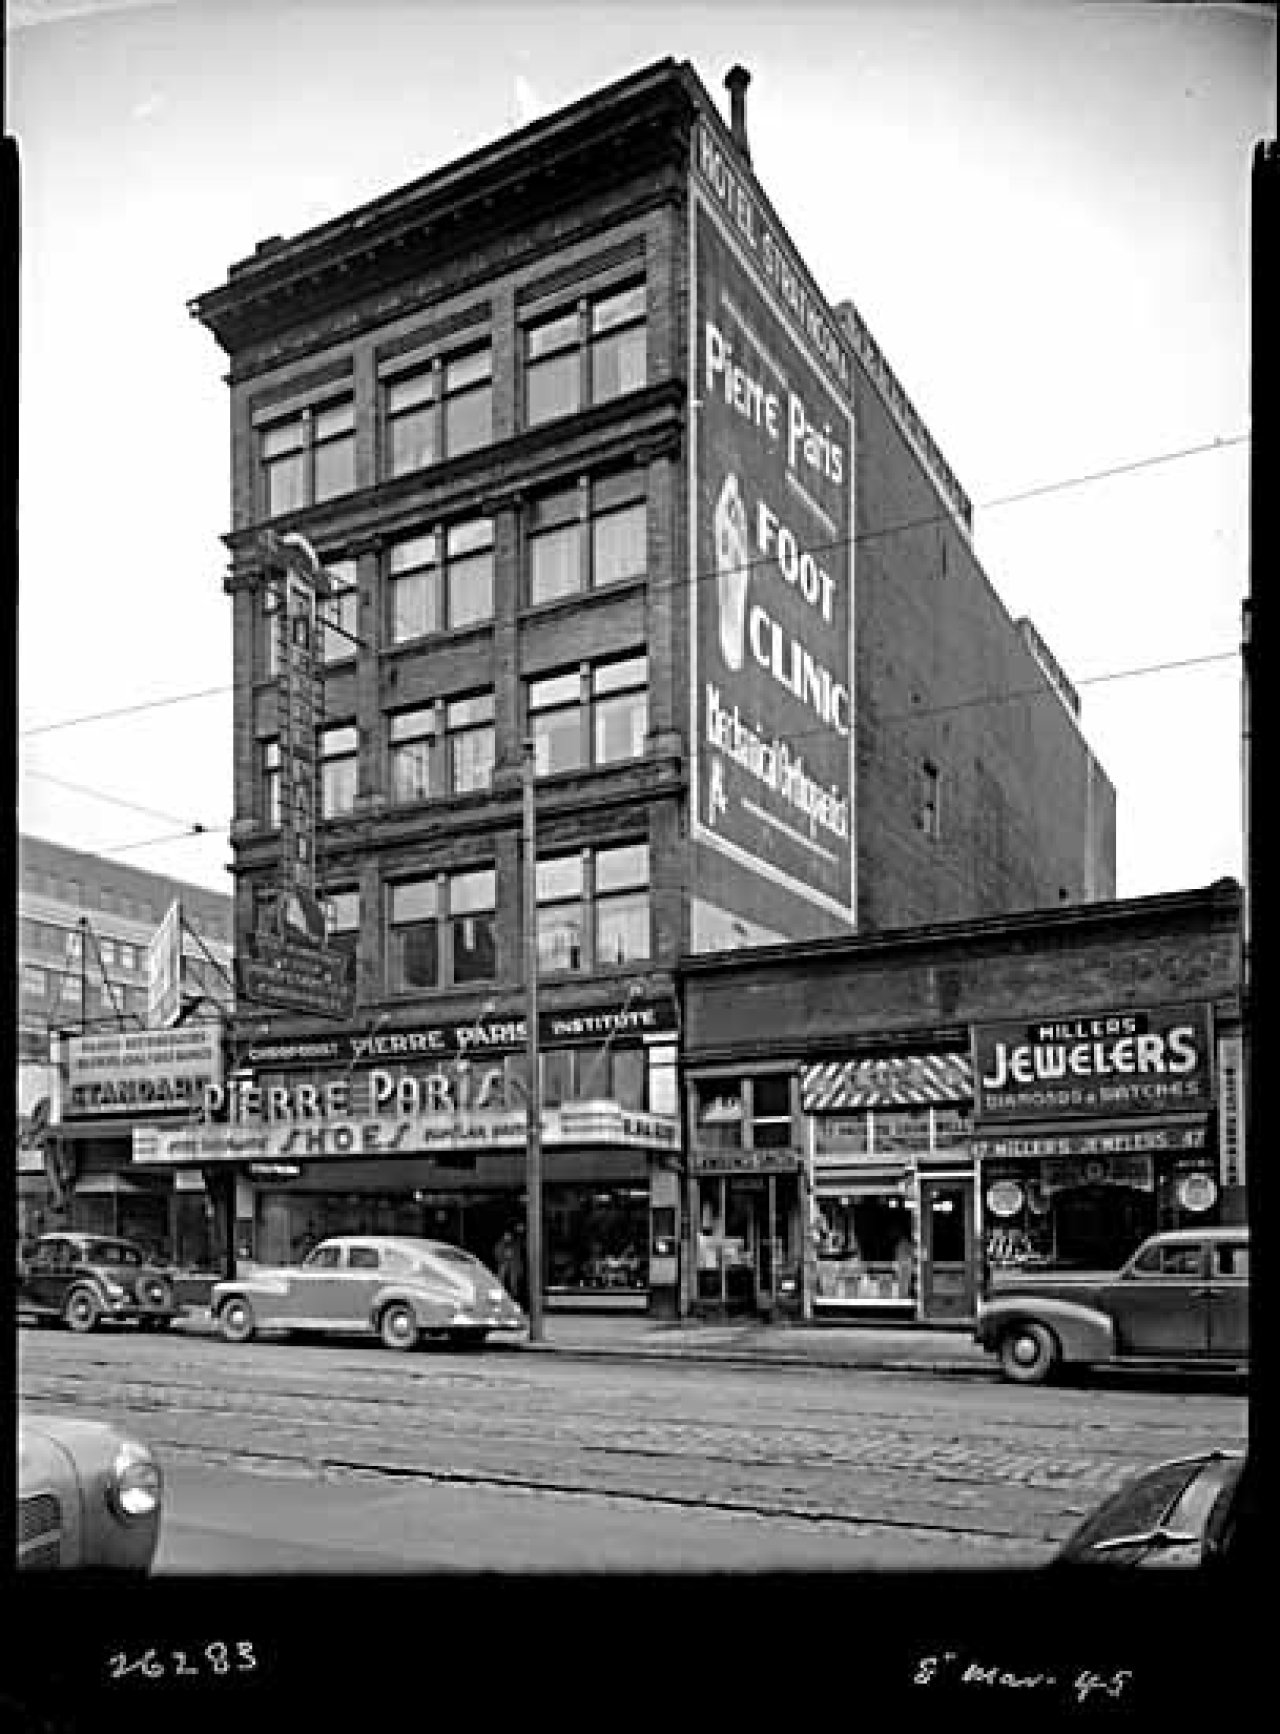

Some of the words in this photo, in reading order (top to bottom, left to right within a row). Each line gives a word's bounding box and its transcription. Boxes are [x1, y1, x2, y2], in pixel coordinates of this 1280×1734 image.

[701, 123, 757, 248] HOTEL
[788, 390, 843, 485] Paris
[757, 499, 835, 622] FOOT
[750, 605, 850, 735] CLINIC
[350, 1031, 446, 1057] PIERRE
[456, 1021, 527, 1048] PARIS
[552, 1009, 654, 1035] INSTITUTE
[982, 1027, 1197, 1089] JEWELERS
[203, 1080, 350, 1126] PIERRE
[368, 1068, 504, 1120] PARIS
[277, 1120, 411, 1153] SHOES
[107, 1641, 257, 1678] 26283
